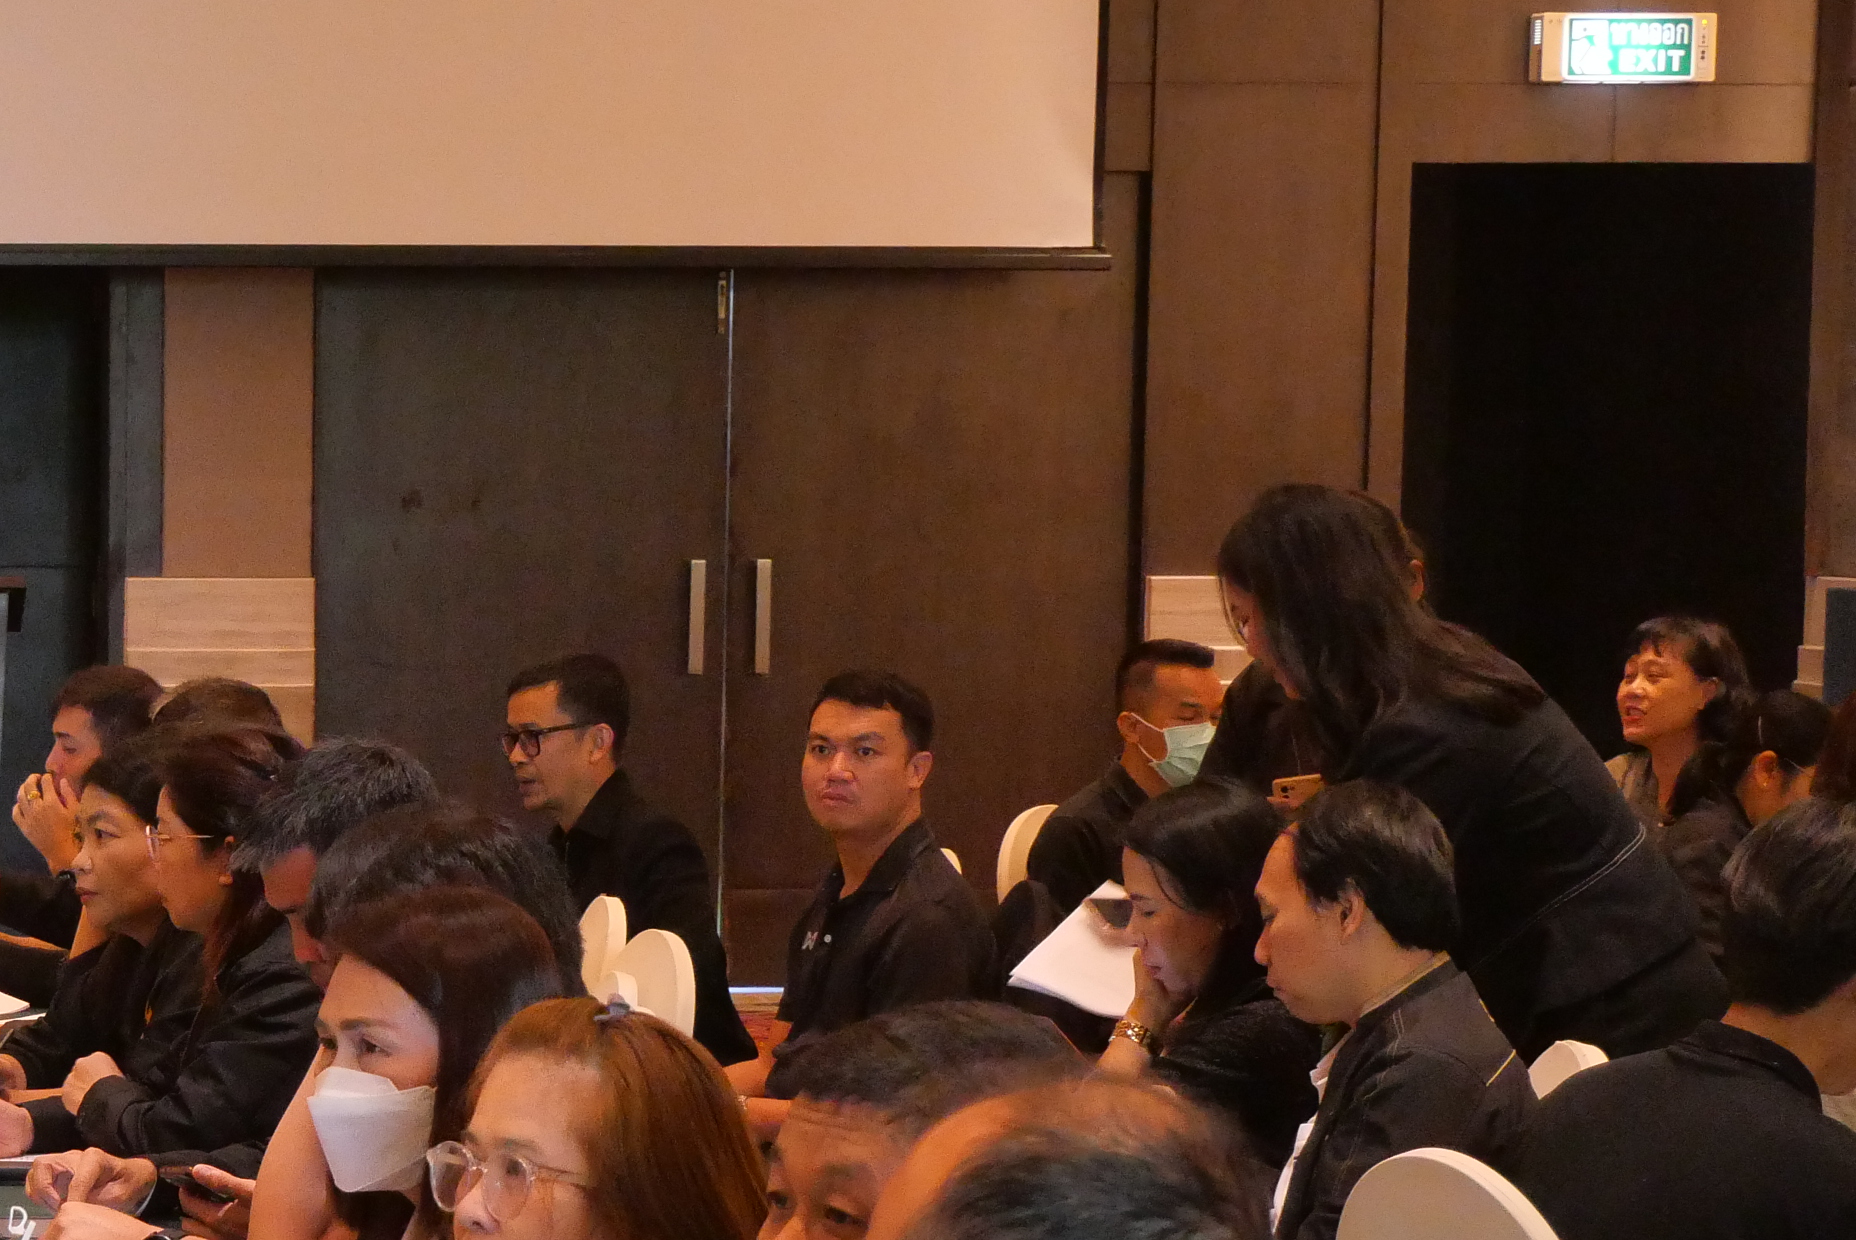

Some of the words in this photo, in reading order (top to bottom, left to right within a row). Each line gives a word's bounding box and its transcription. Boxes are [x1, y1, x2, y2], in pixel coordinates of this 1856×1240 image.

[1609, 22, 1690, 46] ทางออก
[1618, 48, 1686, 73] EXIT
